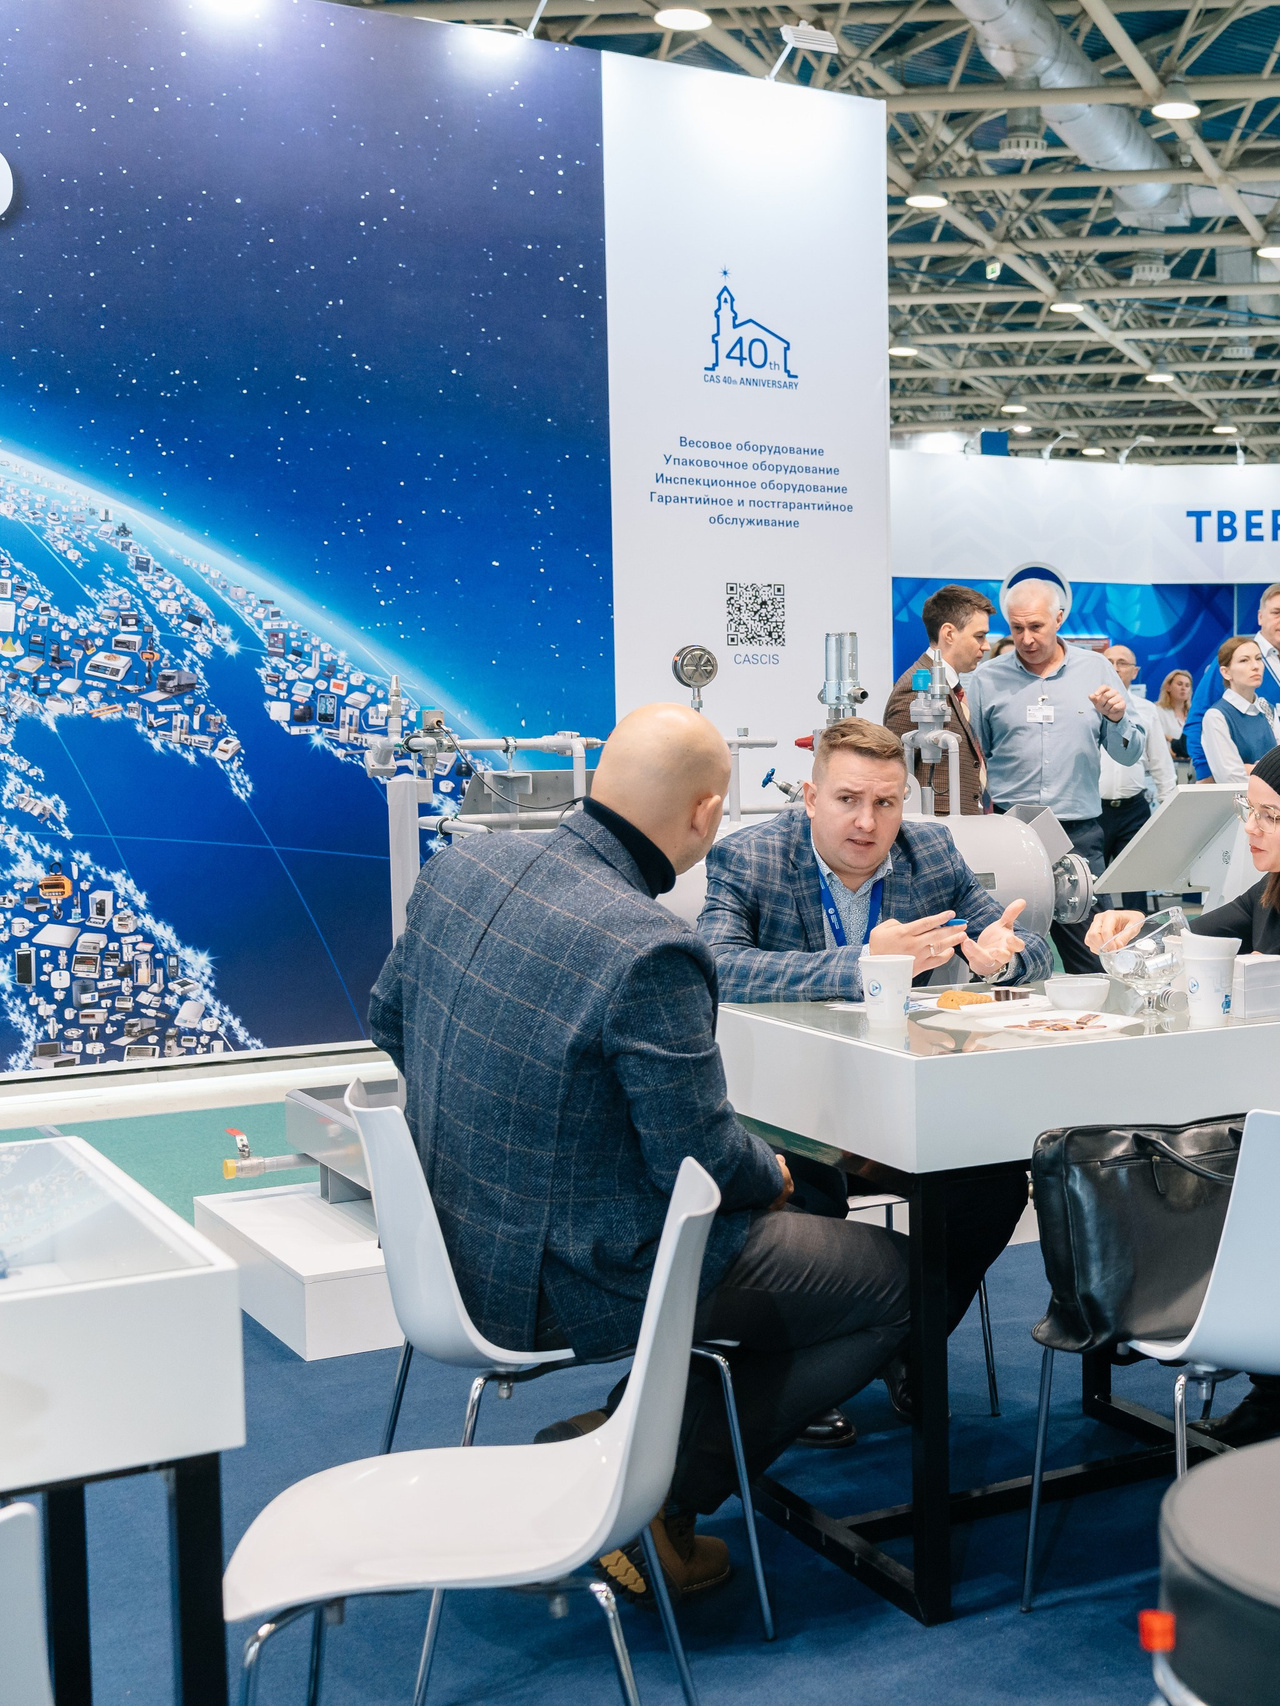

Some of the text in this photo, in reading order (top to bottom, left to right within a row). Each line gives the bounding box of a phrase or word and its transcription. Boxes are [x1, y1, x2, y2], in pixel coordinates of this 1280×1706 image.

[703, 374, 721, 384] CAS
[739, 377, 799, 390] ANNIVERSARY
[679, 436, 825, 457] Весовое оборудование
[663, 454, 840, 476] Упаковочное оборудование
[655, 472, 848, 494] Инспекционное оборудование
[650, 492, 853, 513] Гарантийное и постгарантийное
[709, 514, 800, 528] обслуживание
[733, 653, 780, 665] CASCIS
